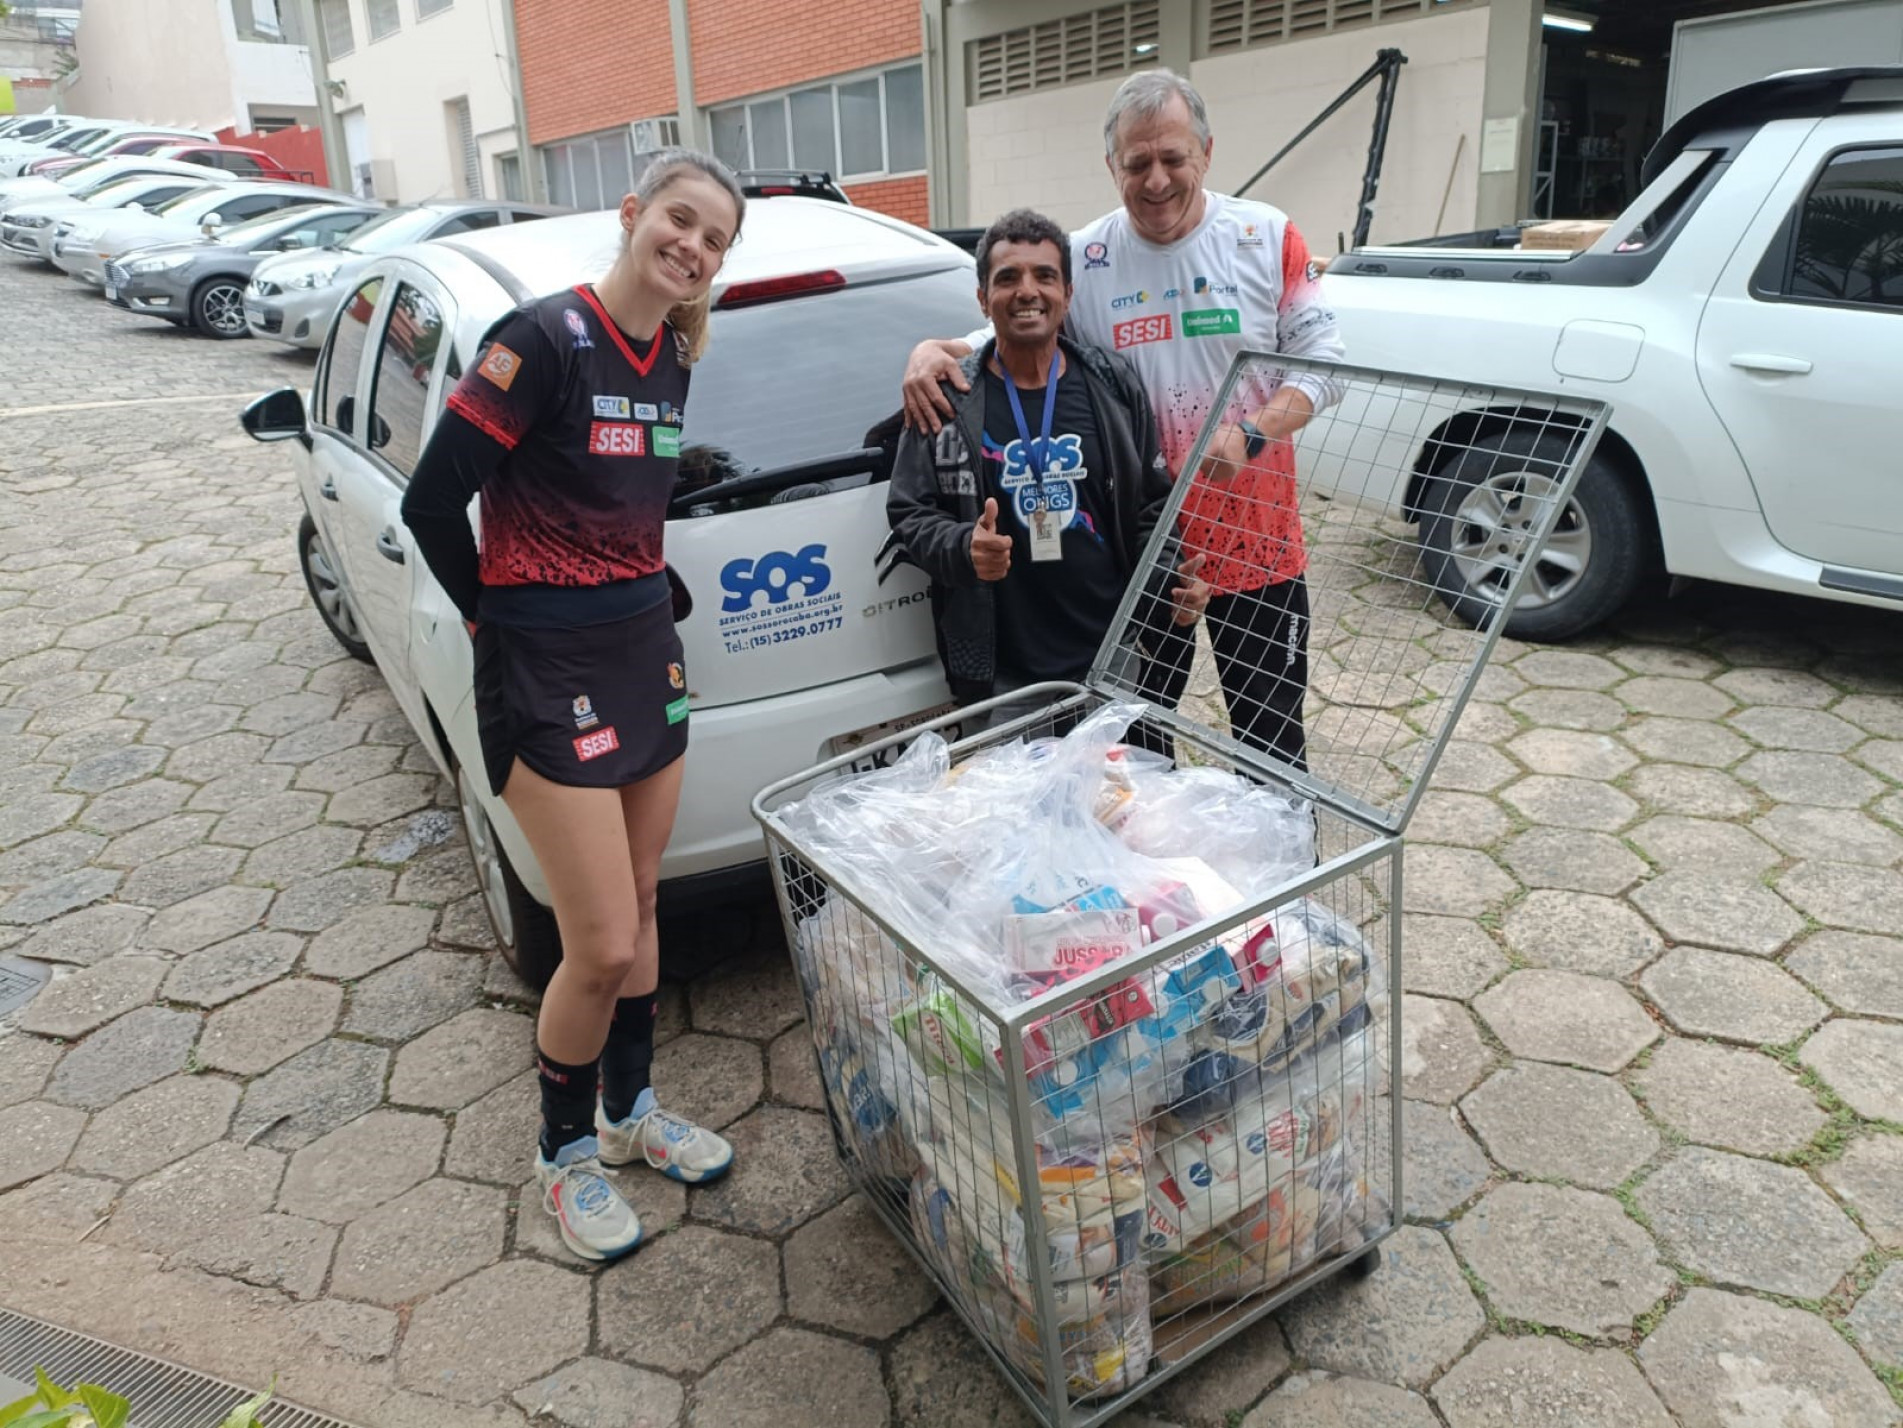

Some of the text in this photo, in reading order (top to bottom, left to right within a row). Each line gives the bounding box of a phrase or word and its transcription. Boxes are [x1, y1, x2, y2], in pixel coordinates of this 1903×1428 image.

[1111, 294, 1137, 309] CITY
[1118, 317, 1167, 347] SESI
[597, 398, 618, 411] CITY
[596, 427, 640, 453] SESI
[720, 543, 831, 613] SOS
[719, 591, 842, 626] SERVIÇO DE OBRAS SOCIAIS
[722, 603, 843, 638] www.sossorocaba.org.br
[773, 616, 843, 644] 3229.0777
[581, 731, 614, 758] SESI
